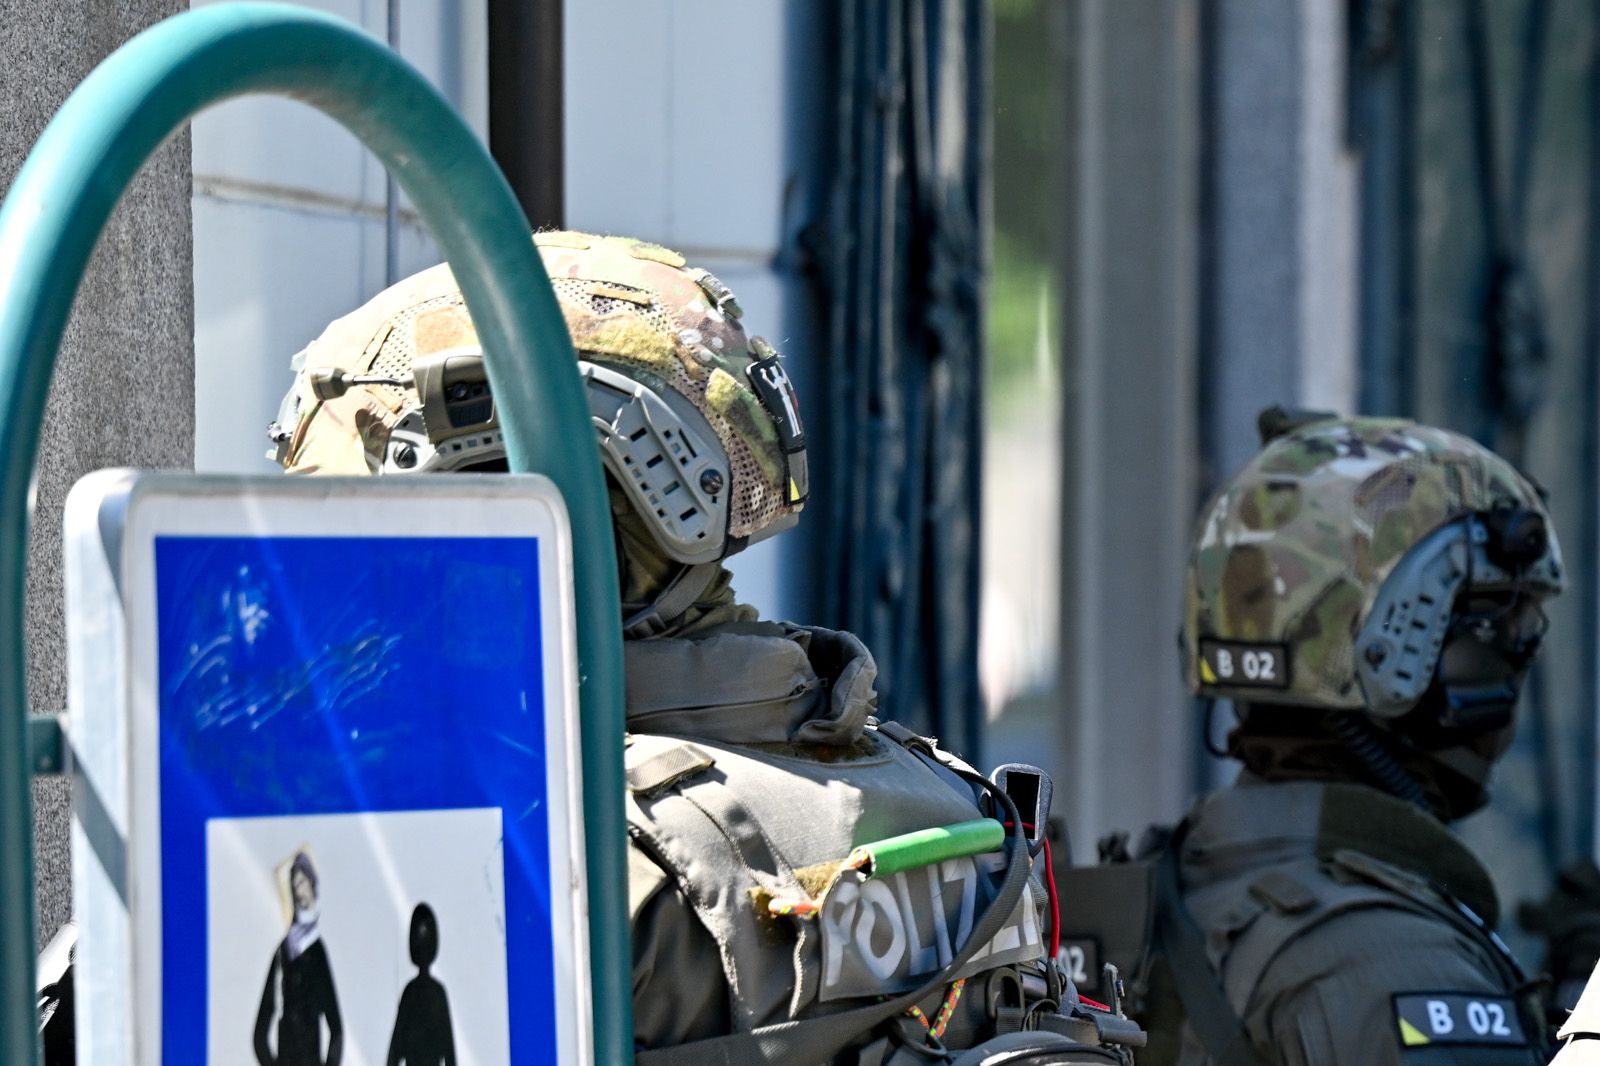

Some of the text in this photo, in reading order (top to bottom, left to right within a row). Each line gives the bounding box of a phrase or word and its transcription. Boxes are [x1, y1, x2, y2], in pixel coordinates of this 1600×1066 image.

[1217, 648, 1275, 680] B 02
[1427, 1000, 1511, 1036] B 02
